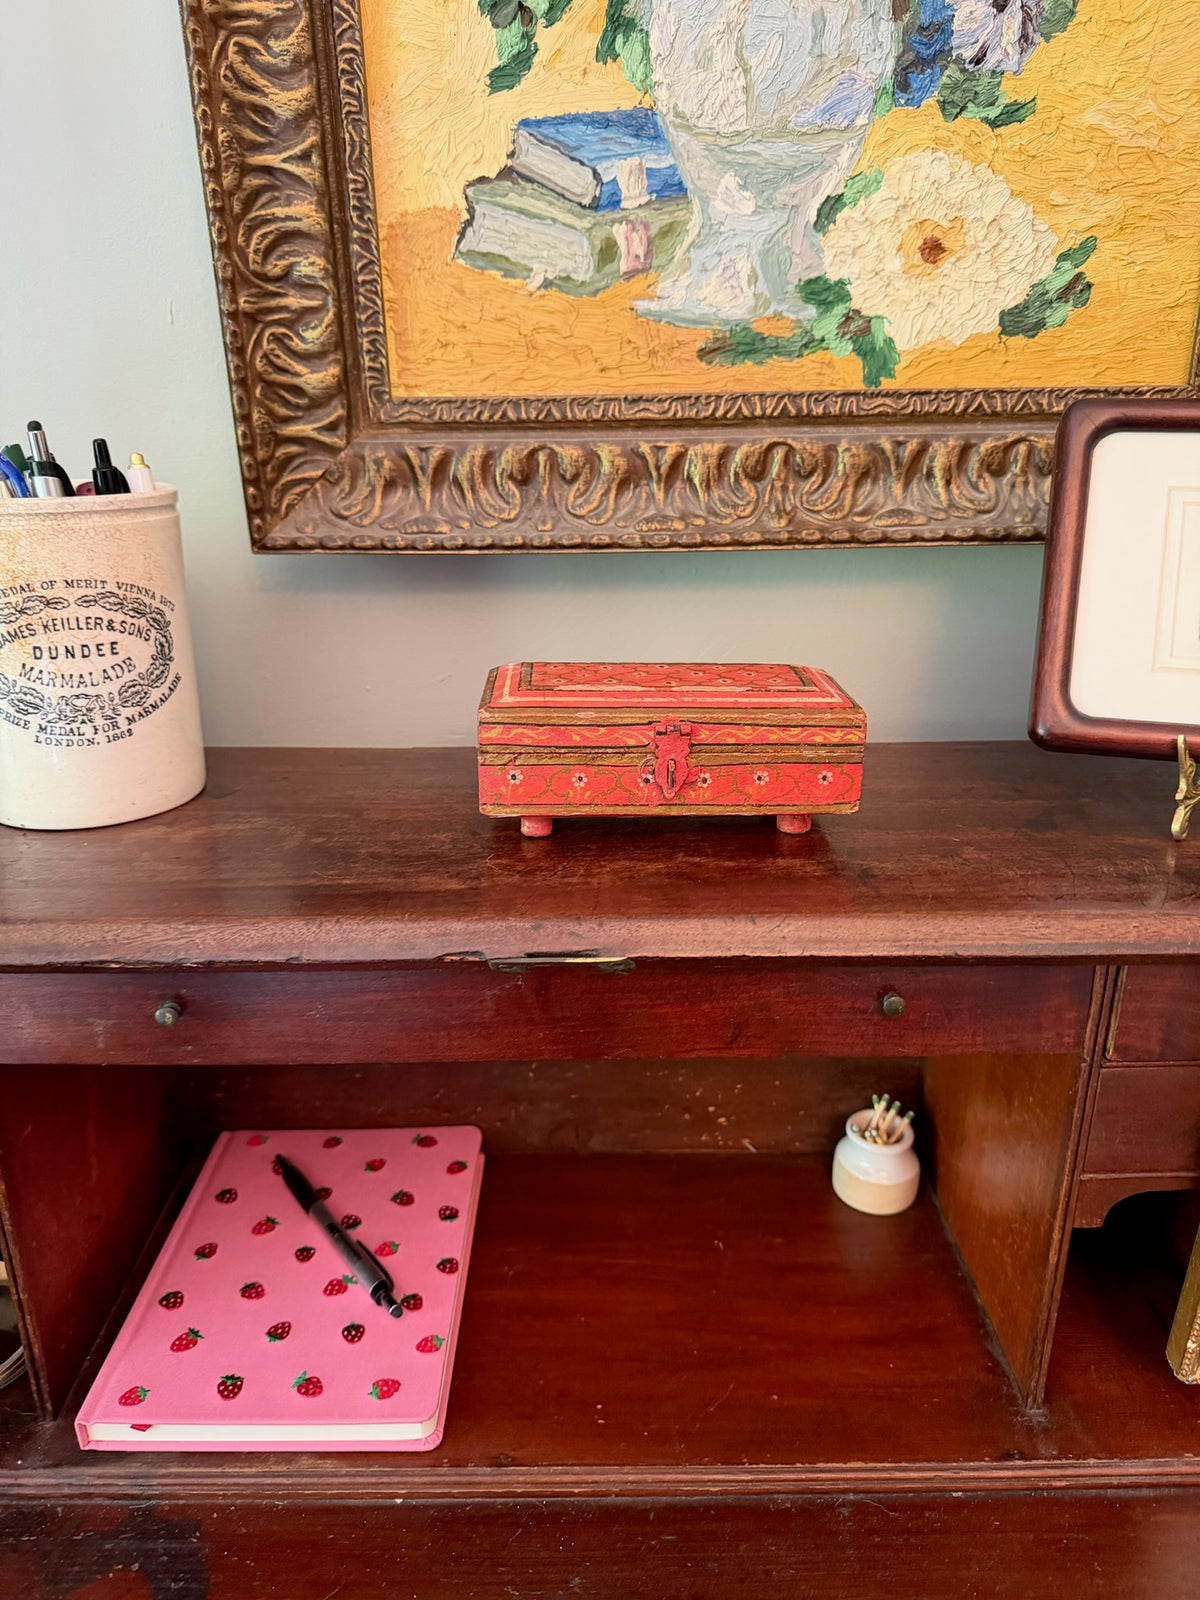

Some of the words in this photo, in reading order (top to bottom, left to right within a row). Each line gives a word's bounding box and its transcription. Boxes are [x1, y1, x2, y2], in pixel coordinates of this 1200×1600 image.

[0, 583, 35, 600] EDAL
[41, 581, 57, 590] OF
[64, 579, 108, 589] MERIT
[116, 581, 156, 601] VIENNA
[40, 616, 104, 633] KEILLER
[33, 641, 119, 660] DUNDEE
[19, 657, 136, 689] MARMALADE
[37, 723, 86, 737] MEDAL
[92, 720, 121, 735] FOR
[125, 672, 182, 726] MARMALADE
[34, 735, 101, 747] LONDON.
[105, 728, 134, 744] 1862
